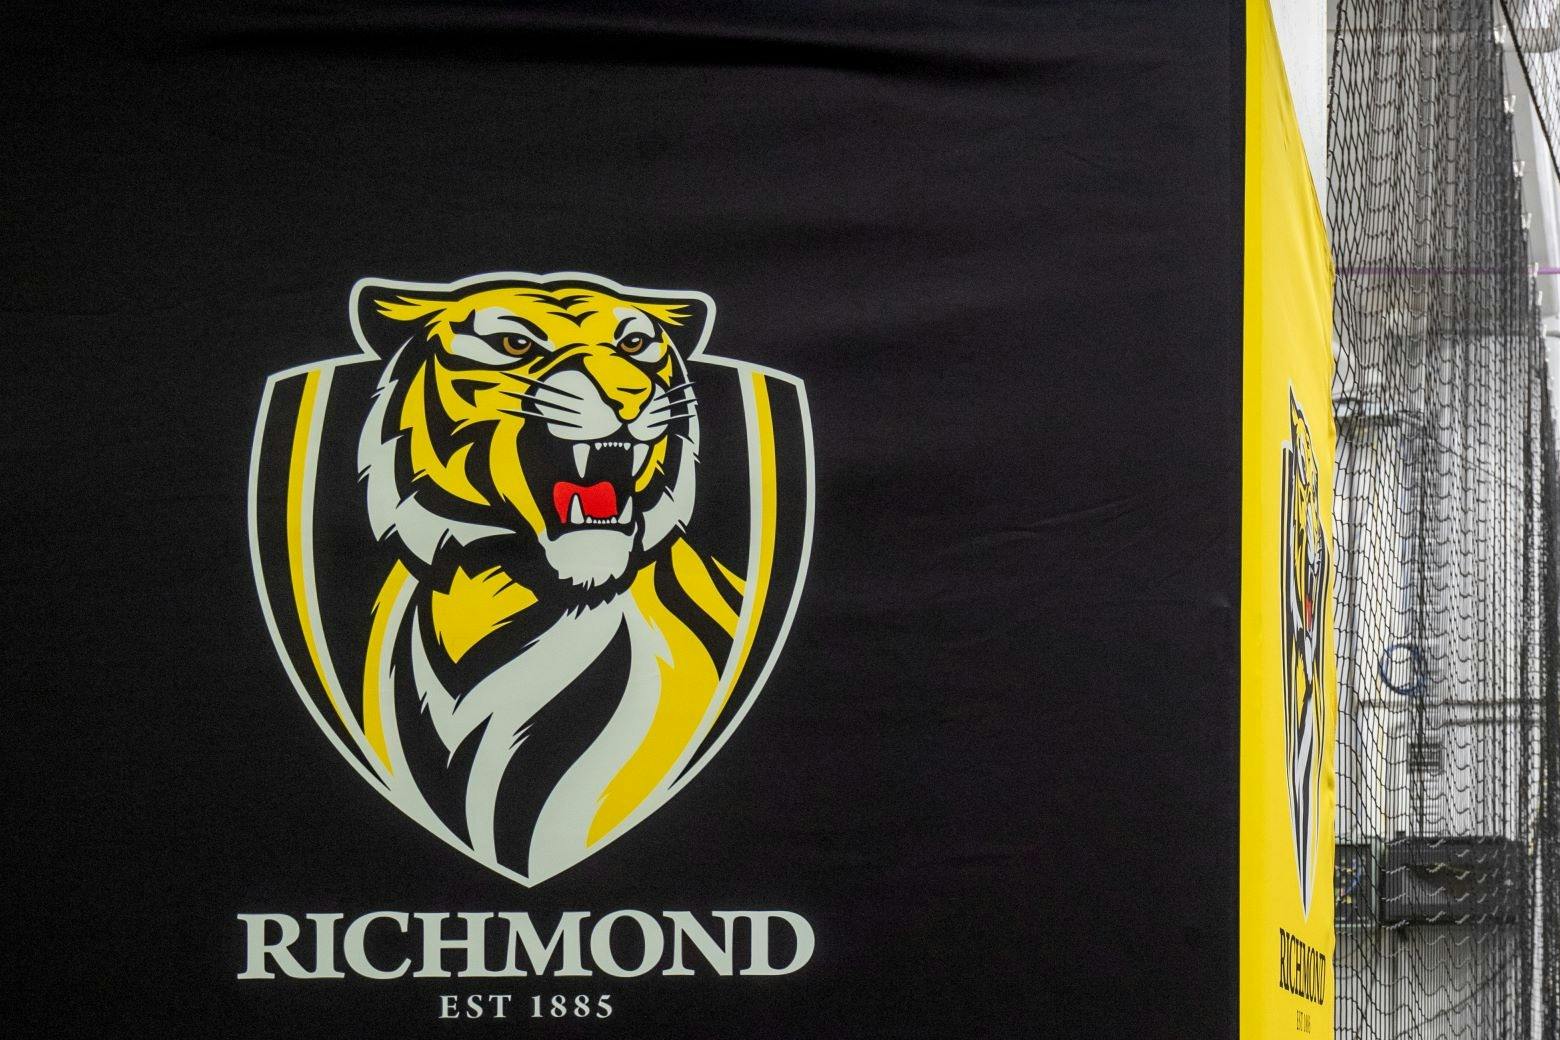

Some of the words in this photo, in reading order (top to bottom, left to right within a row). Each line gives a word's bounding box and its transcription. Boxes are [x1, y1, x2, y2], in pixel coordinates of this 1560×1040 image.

[236, 909, 816, 981] RICHMOND
[1280, 928, 1326, 1005] RICHMOND
[438, 995, 512, 1019] EST
[531, 995, 613, 1018] 1885
